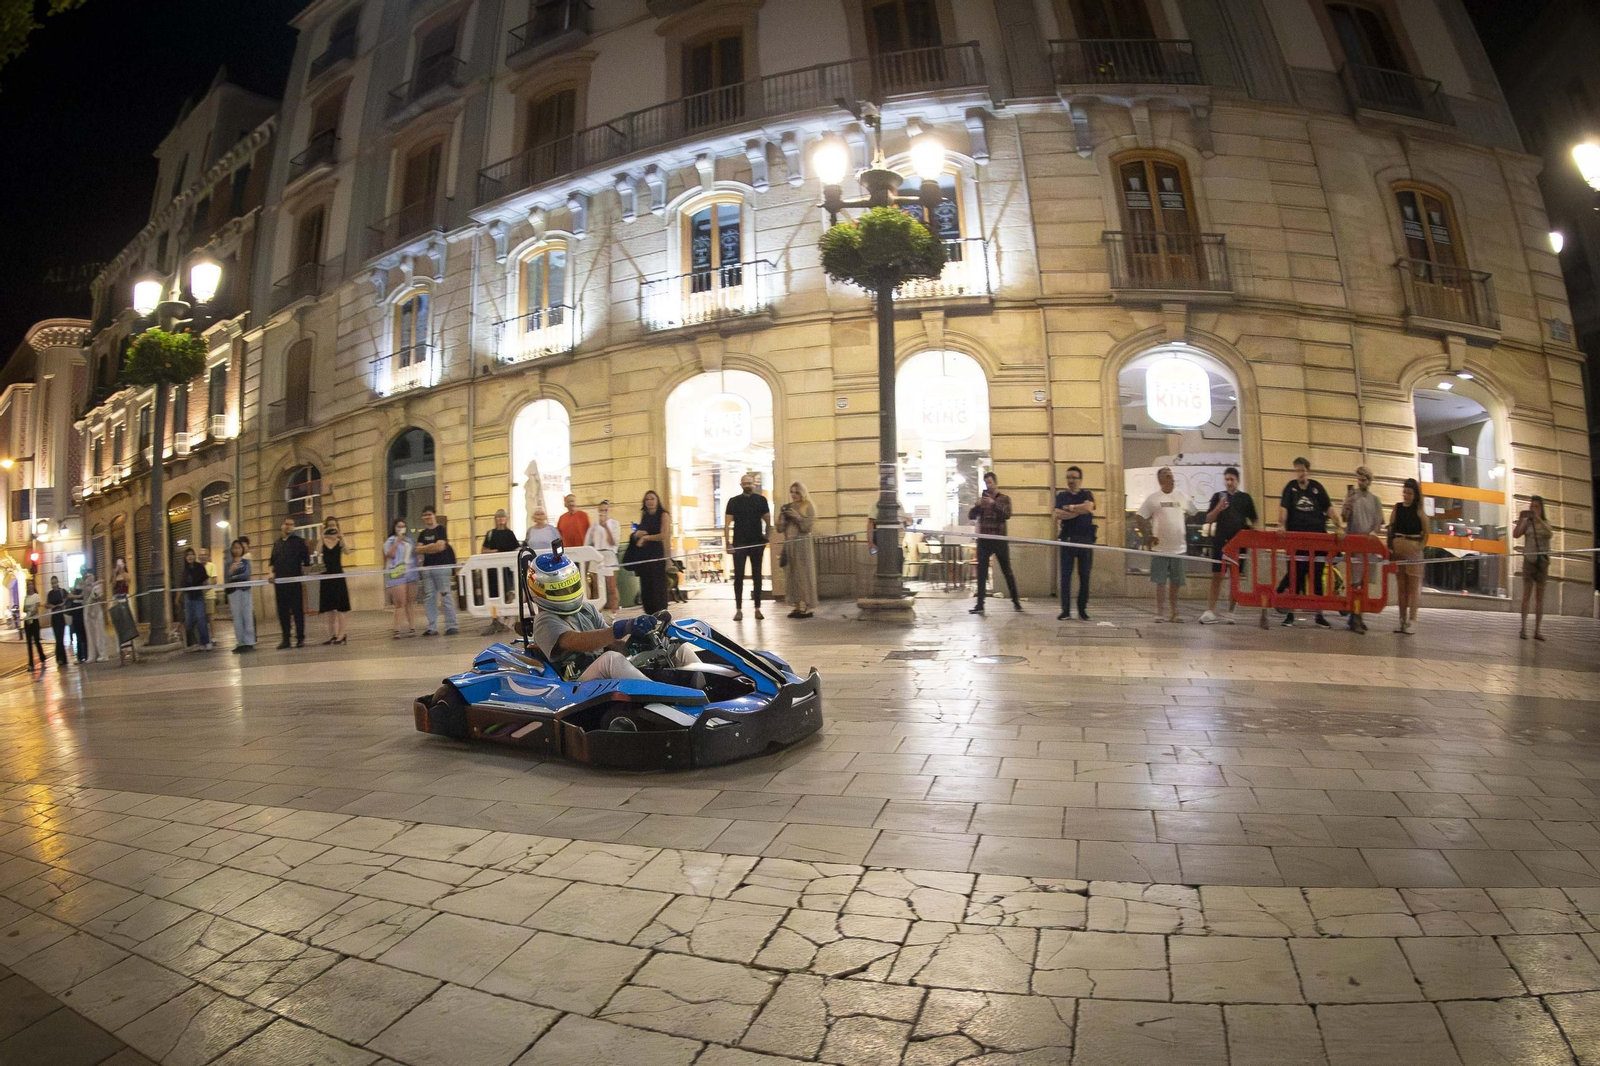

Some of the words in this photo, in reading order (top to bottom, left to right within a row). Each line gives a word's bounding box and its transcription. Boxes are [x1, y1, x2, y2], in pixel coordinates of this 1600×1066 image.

[1156, 393, 1202, 409] KING
[922, 410, 968, 424] KING
[703, 424, 743, 438] KING
